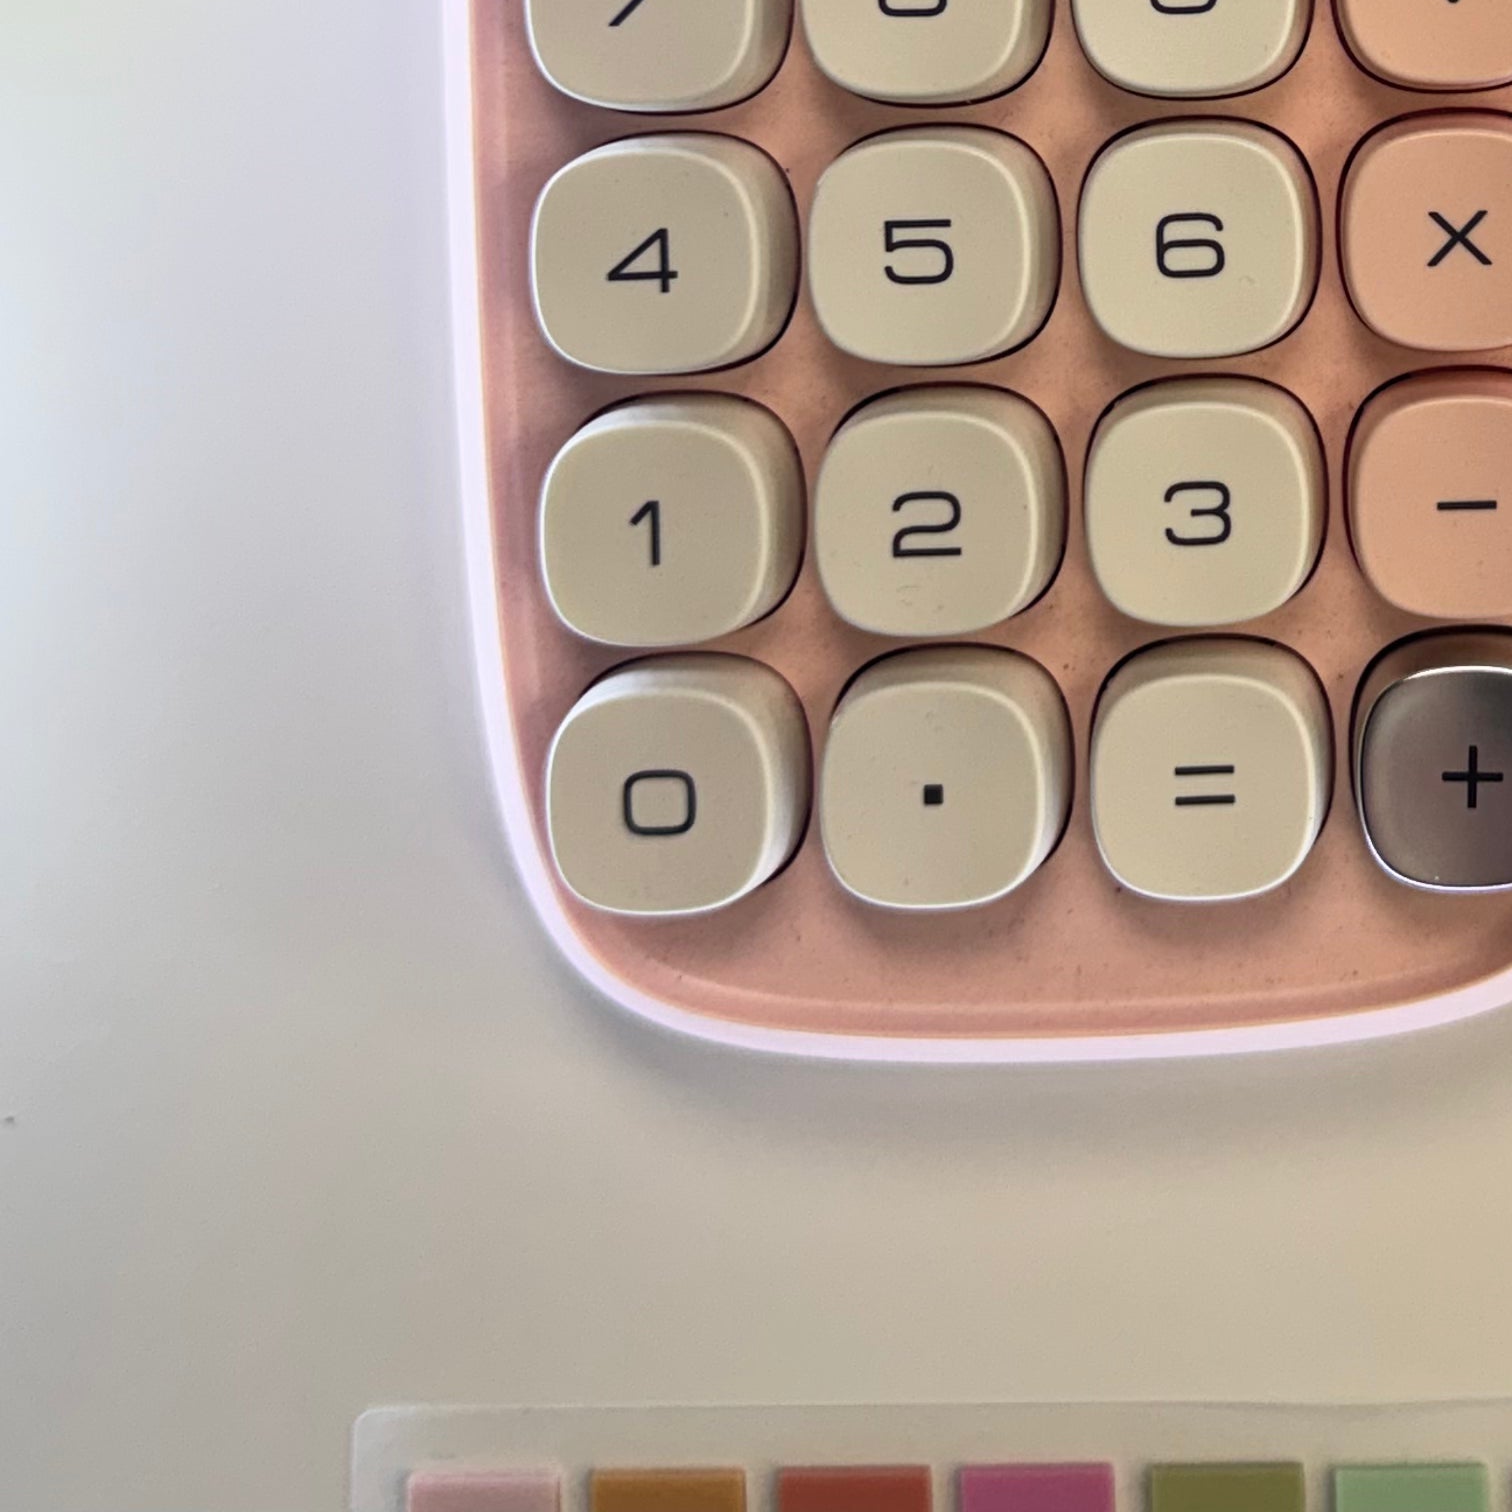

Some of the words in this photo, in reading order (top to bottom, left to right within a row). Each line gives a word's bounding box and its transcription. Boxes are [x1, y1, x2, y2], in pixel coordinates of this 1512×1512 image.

[606, 227, 678, 294] 4
[883, 218, 954, 286] 5
[1155, 212, 1226, 279] 6
[629, 500, 661, 567] 1
[891, 490, 962, 559] 2
[1163, 480, 1232, 547] 3
[621, 769, 697, 838] 0
